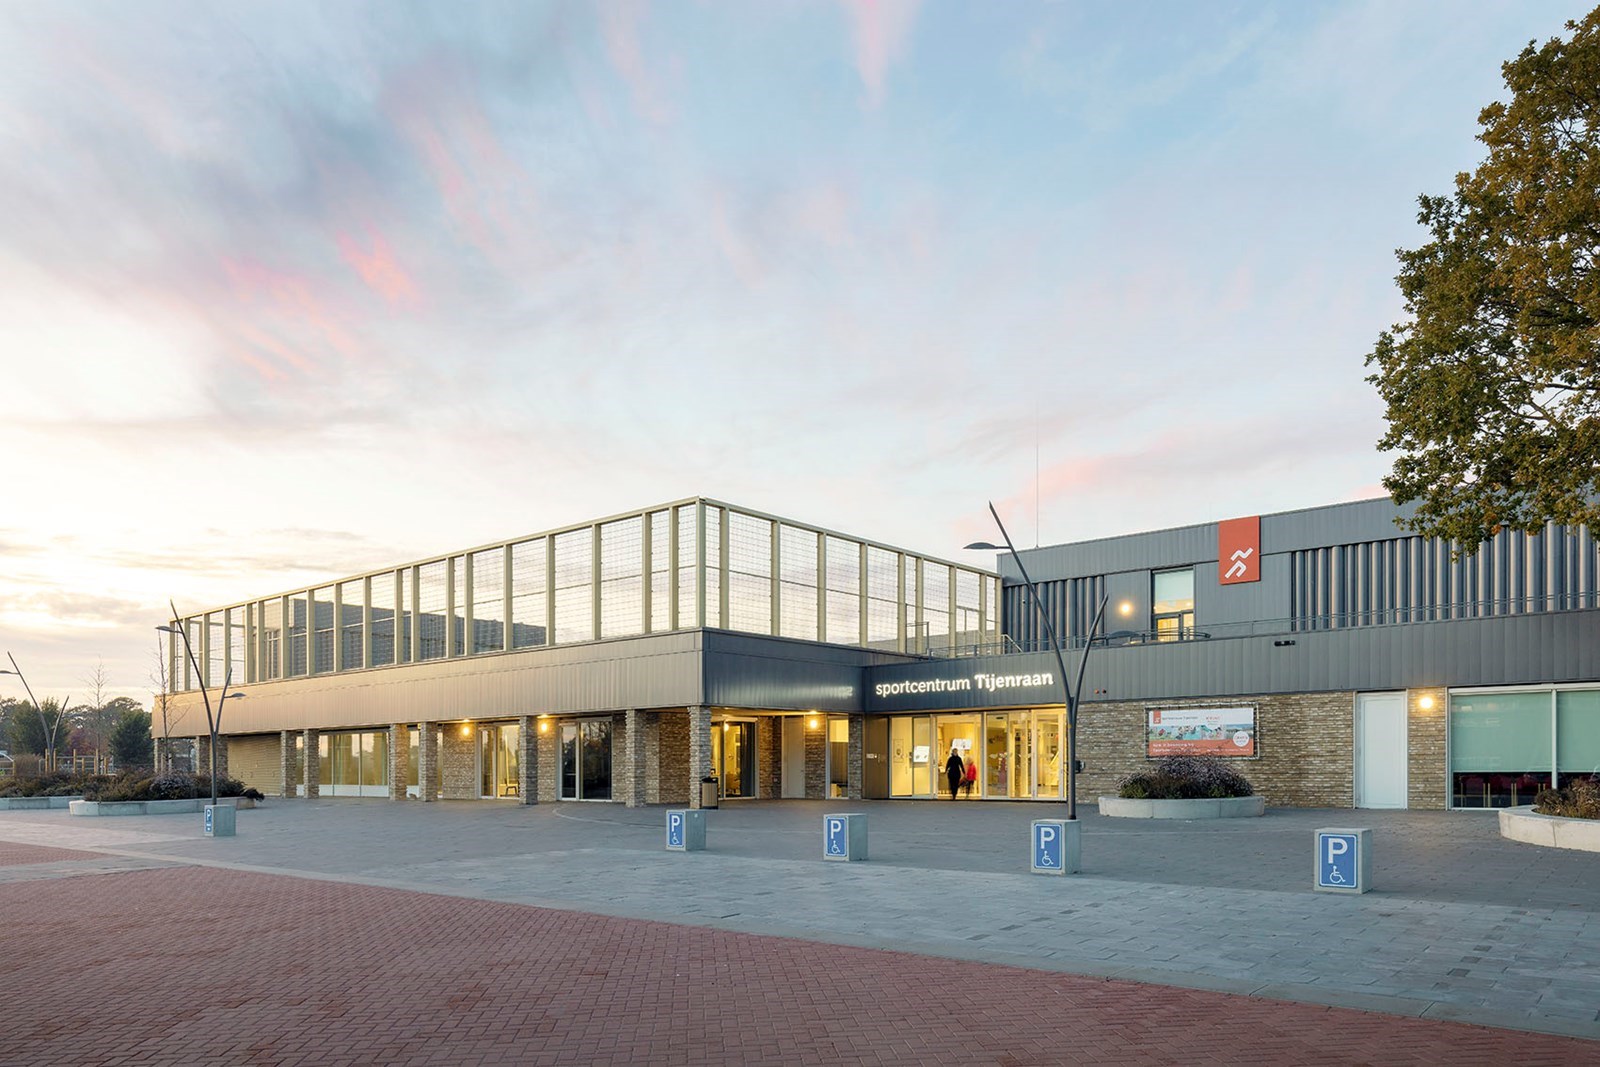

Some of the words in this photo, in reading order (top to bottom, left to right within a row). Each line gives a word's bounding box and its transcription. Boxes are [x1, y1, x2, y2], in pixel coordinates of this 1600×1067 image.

[875, 678, 971, 698] sportcentrum
[974, 672, 1054, 692] Tijenraan
[206, 809, 212, 821] P
[671, 815, 681, 832] P
[830, 820, 842, 839] P
[1040, 827, 1055, 849] P
[1328, 838, 1348, 864] P
